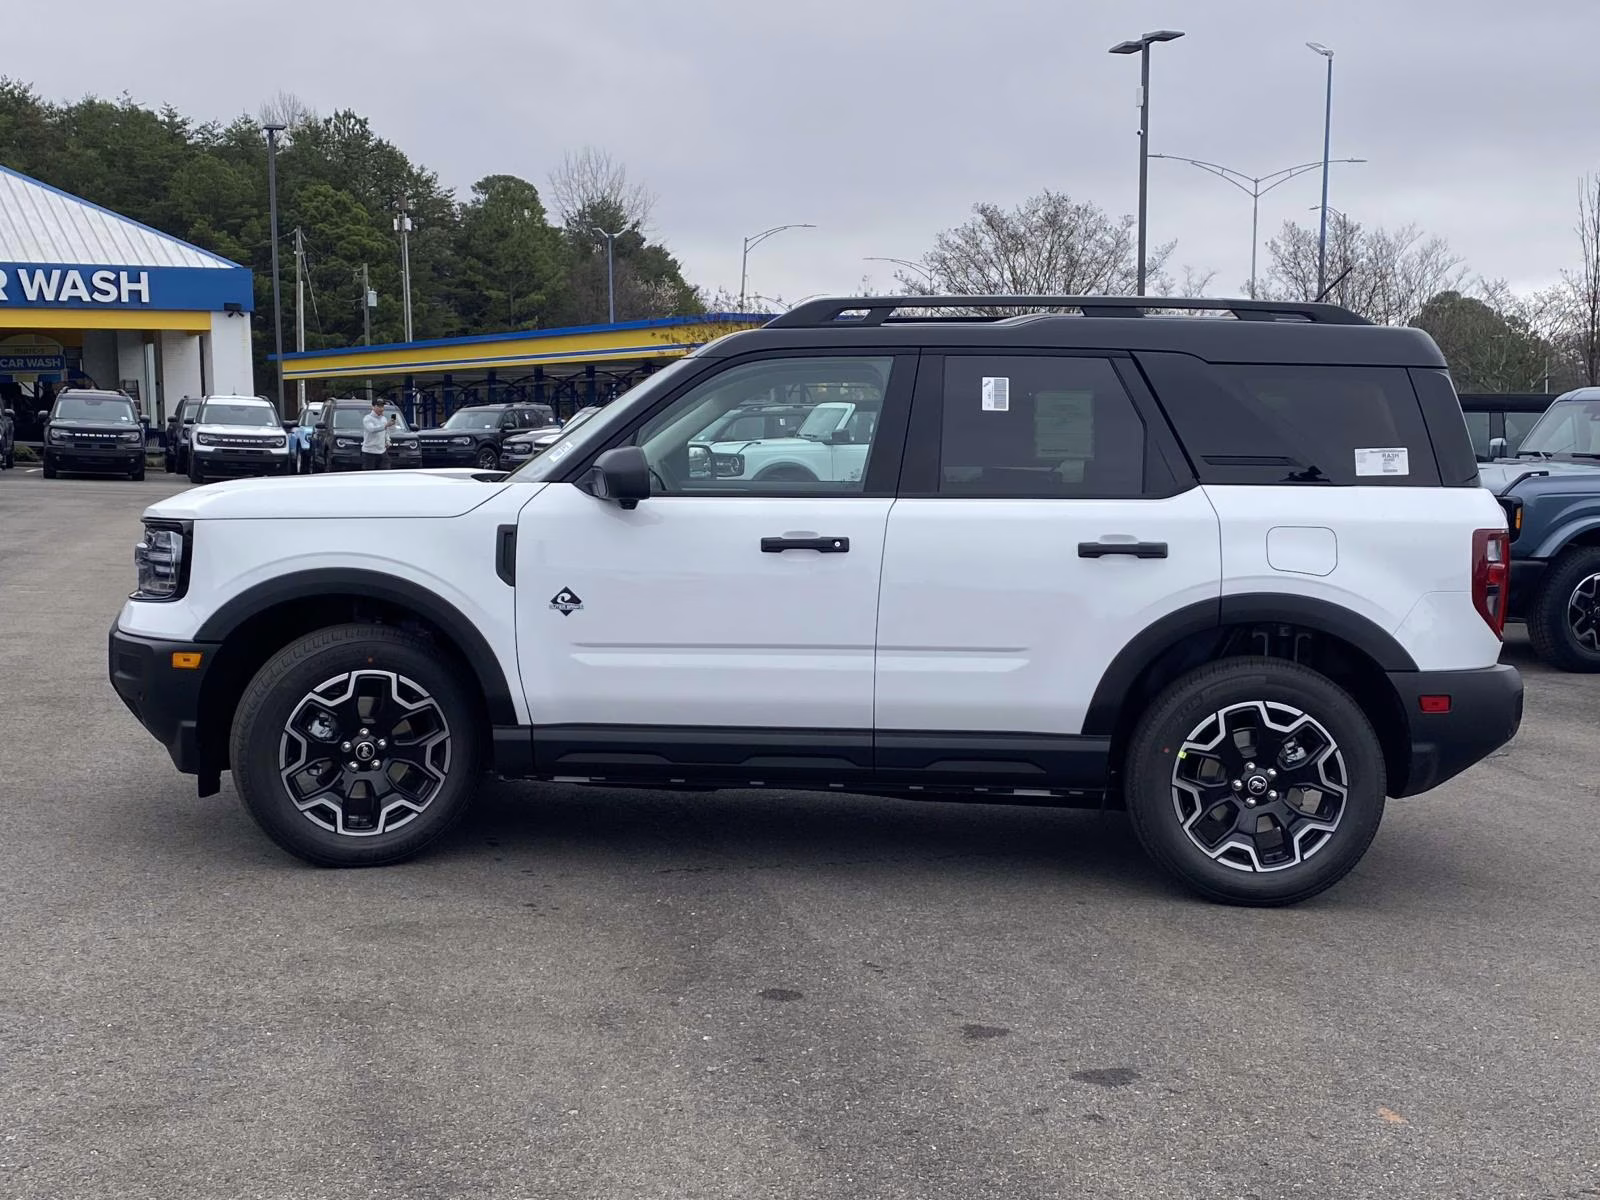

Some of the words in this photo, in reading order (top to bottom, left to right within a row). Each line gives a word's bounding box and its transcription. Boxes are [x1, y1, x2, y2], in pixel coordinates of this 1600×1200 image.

[17, 268, 149, 303] WASH
[0, 358, 24, 368] CAR
[26, 358, 61, 367] WASH
